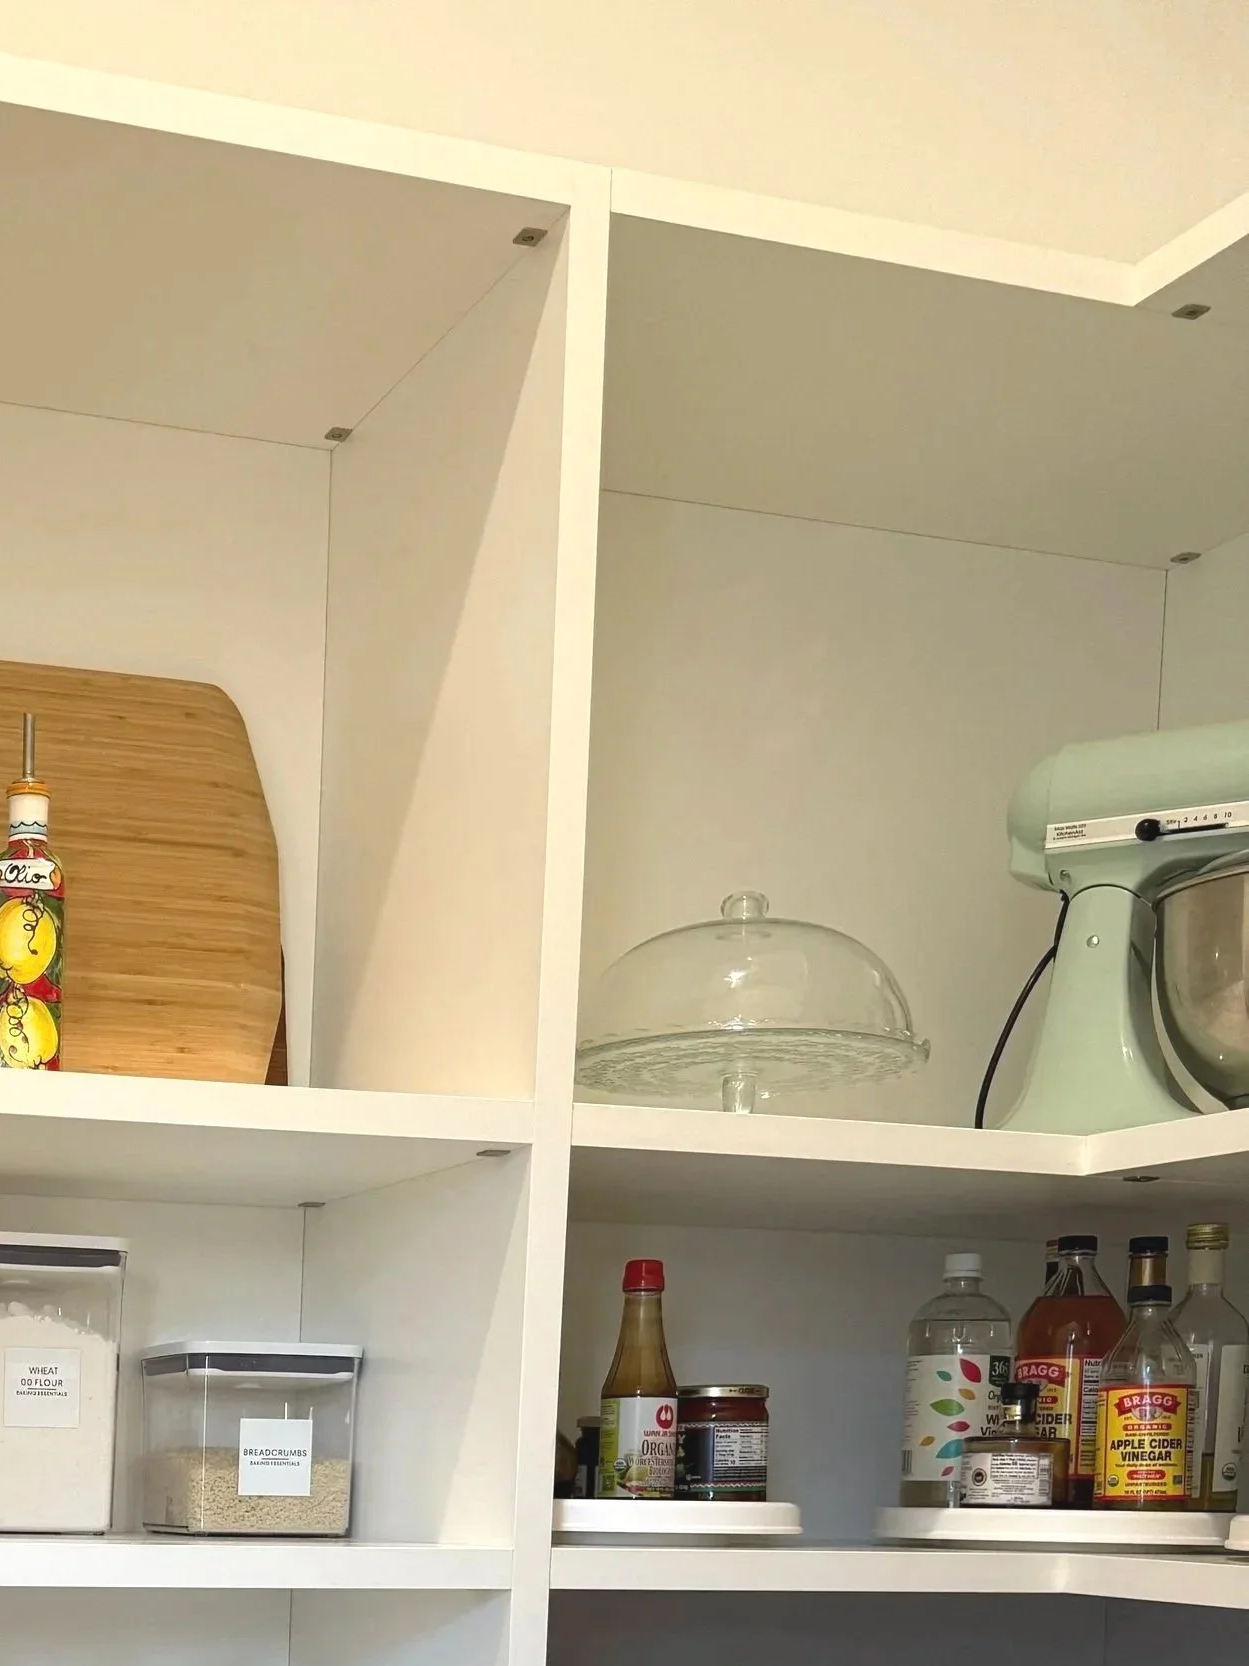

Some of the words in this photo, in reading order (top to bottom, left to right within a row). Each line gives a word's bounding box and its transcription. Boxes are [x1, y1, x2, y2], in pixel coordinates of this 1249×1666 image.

[3, 863, 47, 884] Olio
[29, 1366, 58, 1375] WHEAT
[1017, 1363, 1059, 1378] BRAGG
[35, 1378, 63, 1387] FLOUR
[1123, 1393, 1173, 1407] BRAGG
[1036, 1413, 1072, 1424] CIDER
[1110, 1438, 1145, 1449] APPLE
[1149, 1438, 1182, 1449] CIDER
[243, 1448, 307, 1458] BREADCRUMBS
[1121, 1450, 1172, 1462] VINEGAR
